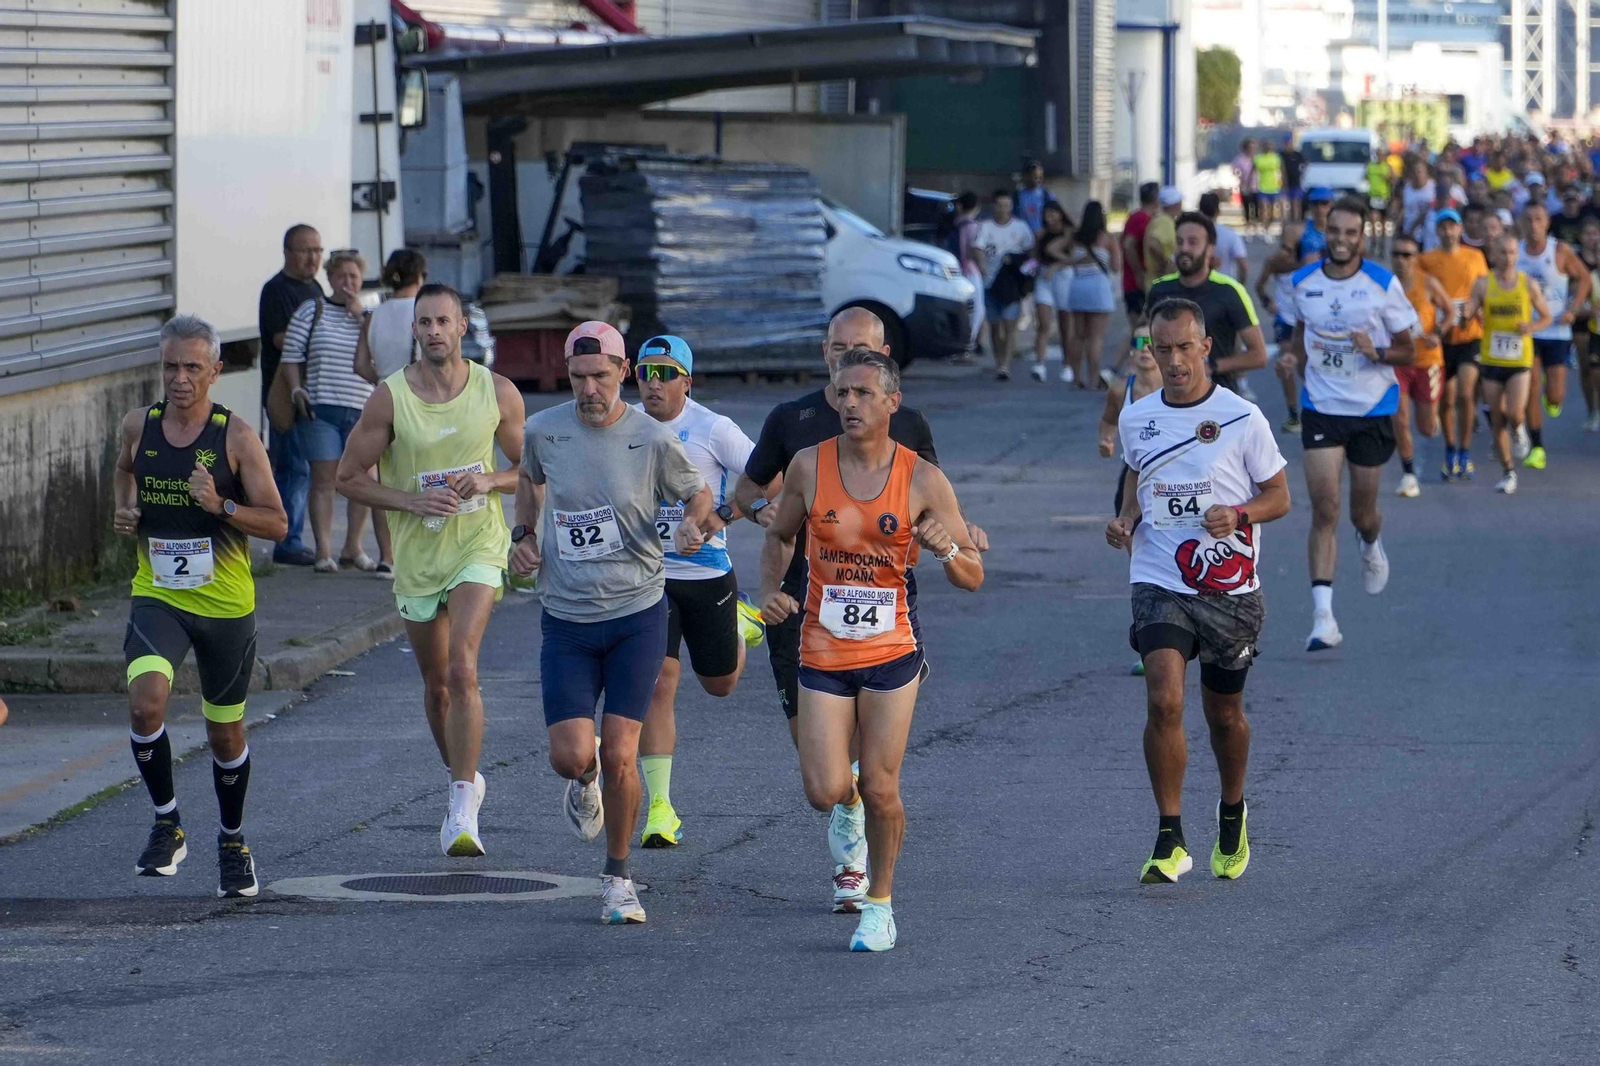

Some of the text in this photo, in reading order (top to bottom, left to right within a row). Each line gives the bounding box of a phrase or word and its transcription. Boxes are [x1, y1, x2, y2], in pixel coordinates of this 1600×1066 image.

[1322, 351, 1344, 368] 26
[1167, 483, 1193, 491] ALFONSO
[1194, 481, 1211, 489] MORO
[140, 491, 191, 507] CARMEN
[1167, 496, 1200, 517] 64
[568, 512, 593, 522] ALFONSO
[594, 508, 612, 518] MORO
[570, 525, 605, 547] 82
[166, 542, 191, 550] ALFONSO
[173, 556, 190, 576] 2
[835, 567, 875, 583] MOAÑA
[846, 589, 876, 598] ALFONSO
[876, 591, 895, 600] MORO
[843, 604, 879, 627] 84
